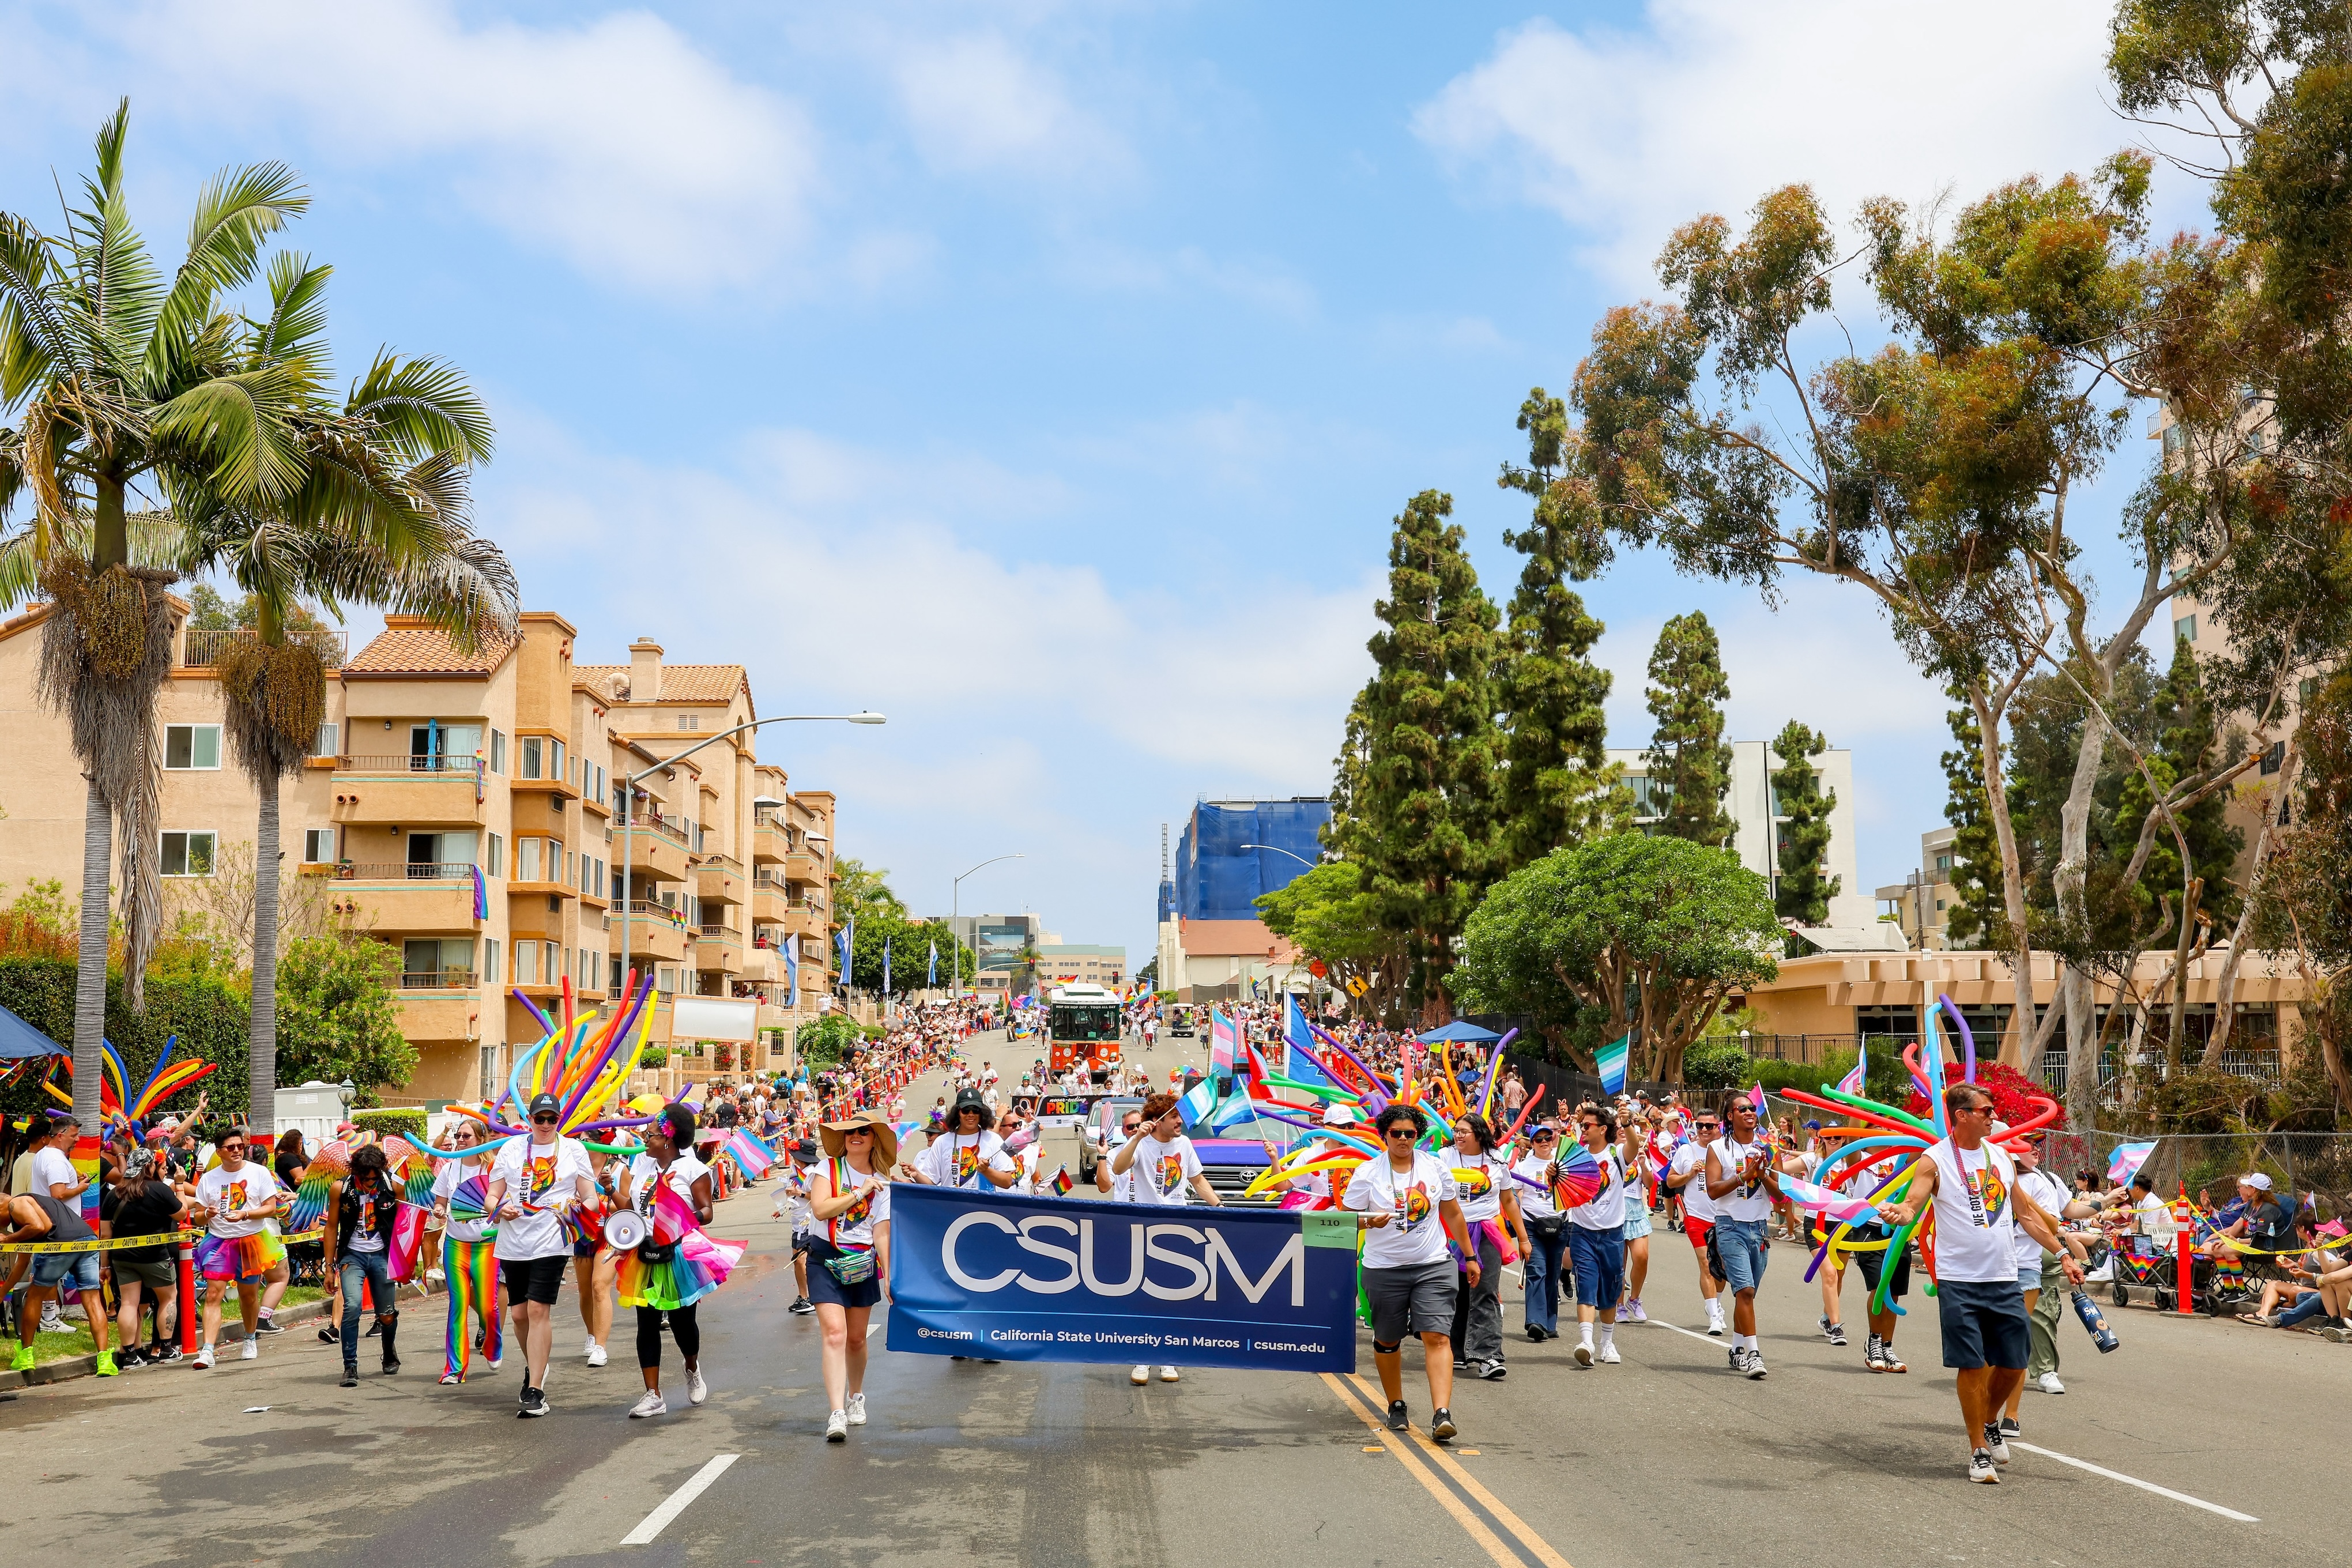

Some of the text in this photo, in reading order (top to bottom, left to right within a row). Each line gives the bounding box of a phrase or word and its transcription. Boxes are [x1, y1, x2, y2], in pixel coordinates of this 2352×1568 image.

[1046, 1102, 1088, 1114] PRIDE
[520, 1178, 530, 1190] GOT
[642, 1174, 657, 1191] PRIDE
[952, 1176, 958, 1185] WE
[1155, 1174, 1163, 1185] GOT
[1156, 1185, 1162, 1194] WE
[1460, 1182, 1469, 1193] GOT
[1737, 1188, 1744, 1197] WE
[519, 1192, 527, 1203] WE
[1969, 1196, 1982, 1211] GOT
[220, 1200, 228, 1210] GOT
[1973, 1213, 1985, 1226] WE
[1396, 1222, 1405, 1231] WE
[43, 1243, 63, 1252] CAUTION
[70, 1242, 89, 1250] CAUTION
[97, 1240, 114, 1249] CAUTION
[122, 1238, 139, 1246] CAUTION
[146, 1235, 162, 1245] CAUTION
[941, 1211, 1305, 1307] CSUSM
[2083, 1306, 2099, 1317] SM
[917, 1328, 973, 1340] @csusm
[990, 1329, 1240, 1348] California State University San Marcos
[1254, 1340, 1325, 1354] csusm.edu
